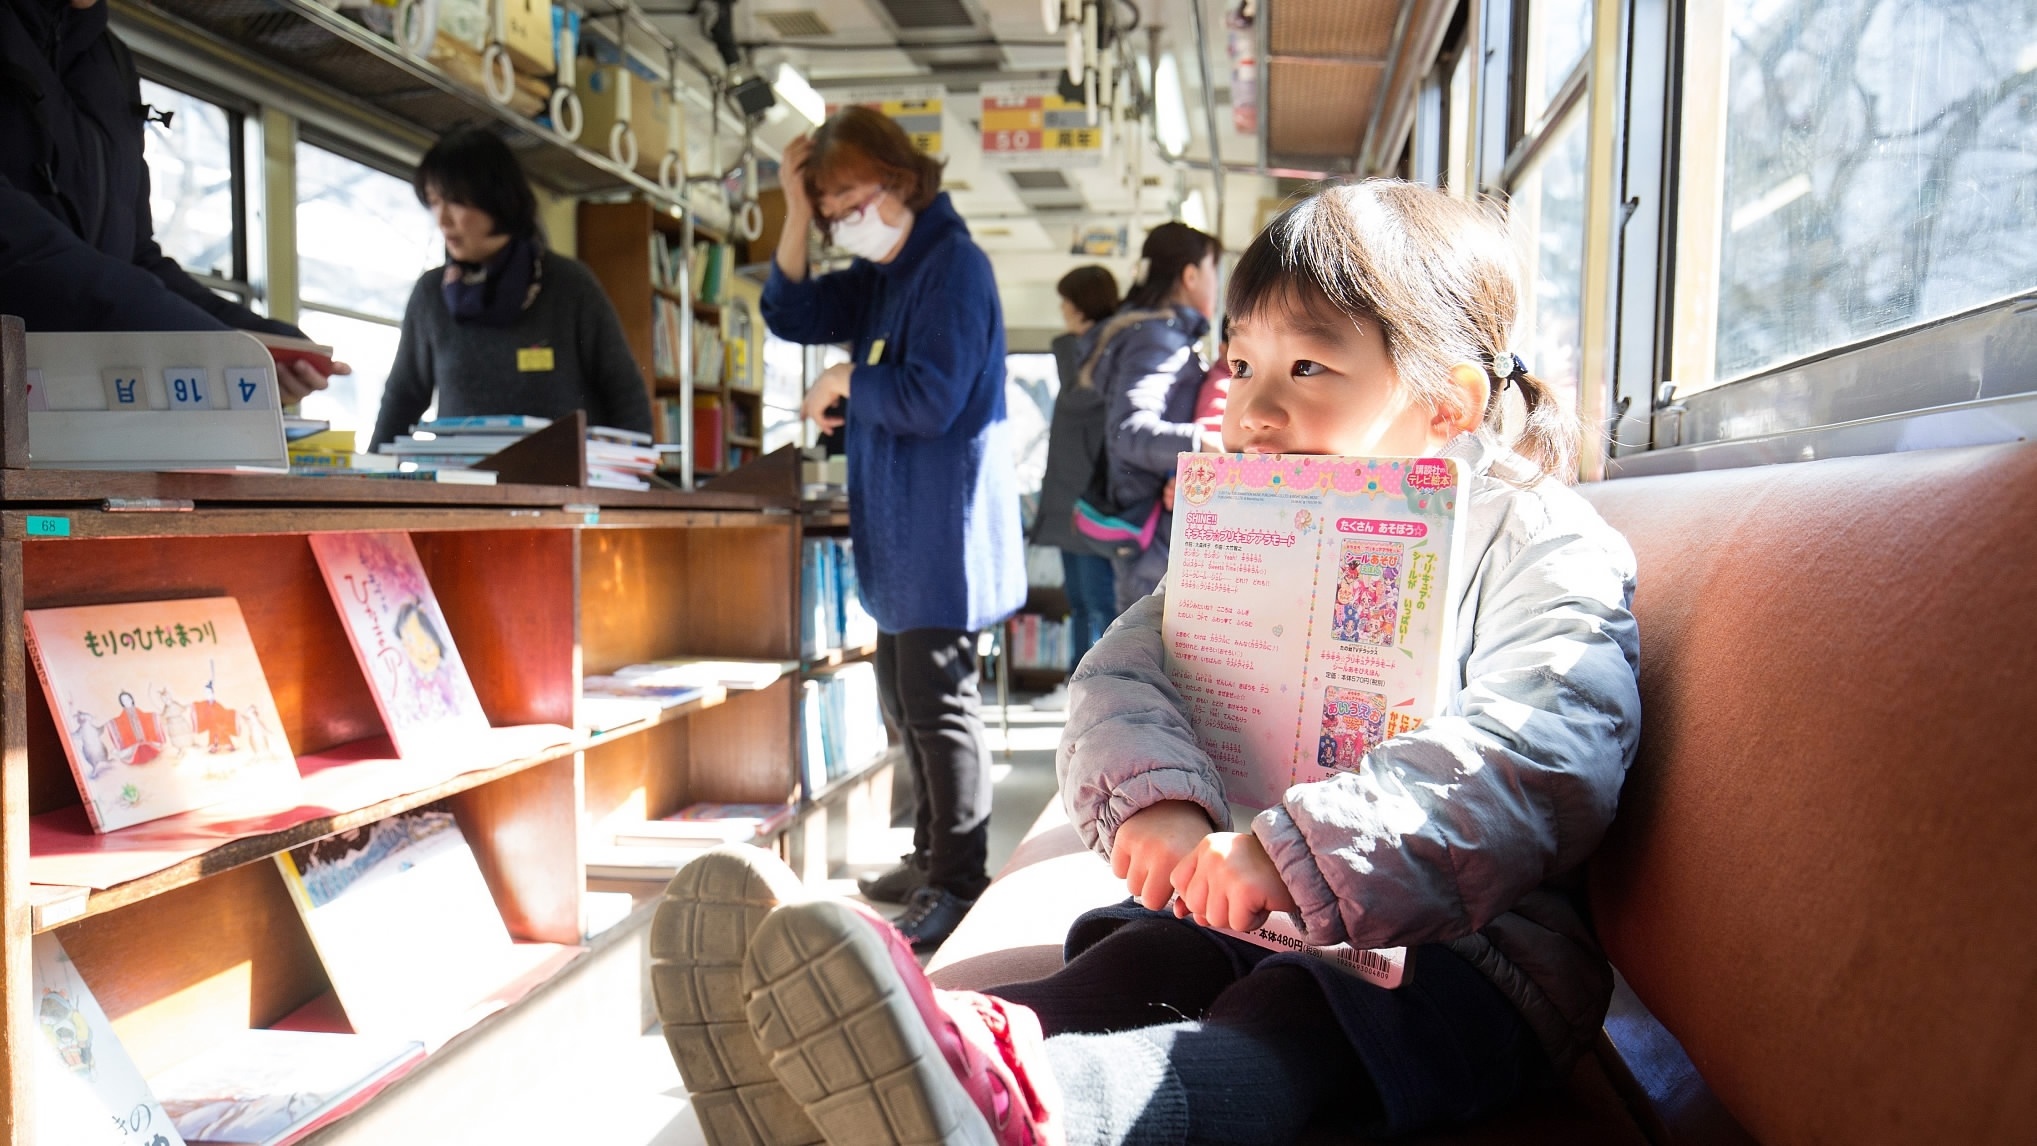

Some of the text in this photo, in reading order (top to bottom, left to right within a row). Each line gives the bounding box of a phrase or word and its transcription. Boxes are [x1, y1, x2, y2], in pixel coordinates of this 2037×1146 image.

[1408, 474, 1450, 486] テレビ絵本
[1186, 513, 1218, 526] SHINE!!
[41, 520, 56, 533] 68
[1340, 521, 1374, 533] たくさん
[1345, 552, 1399, 567] シールあそび
[84, 621, 218, 658] もりのひなまつり
[1328, 702, 1381, 723] あいうえお
